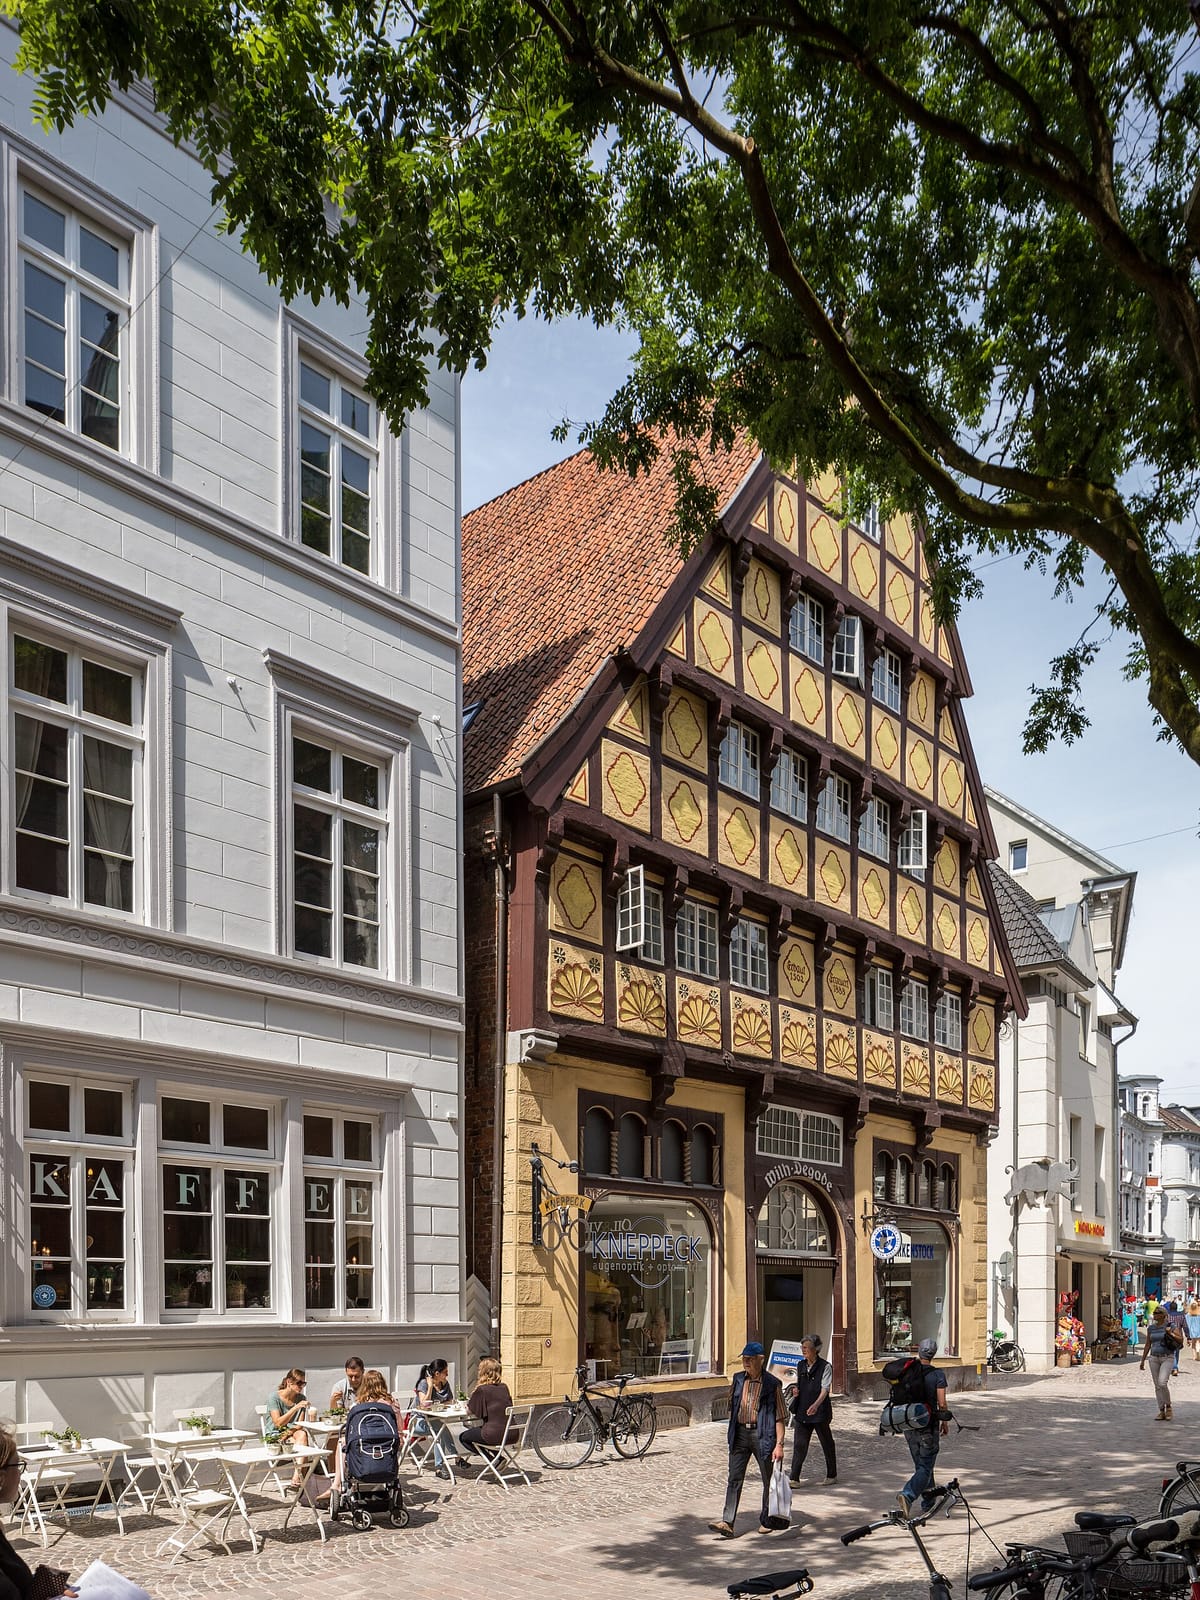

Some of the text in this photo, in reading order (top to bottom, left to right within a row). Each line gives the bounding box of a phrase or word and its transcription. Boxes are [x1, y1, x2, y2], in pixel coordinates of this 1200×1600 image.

[790, 972, 804, 983] 1502
[544, 1196, 586, 1212] KNEPPECK
[591, 1231, 703, 1262] KNEPPECK
[592, 1261, 645, 1273] augenoptik
